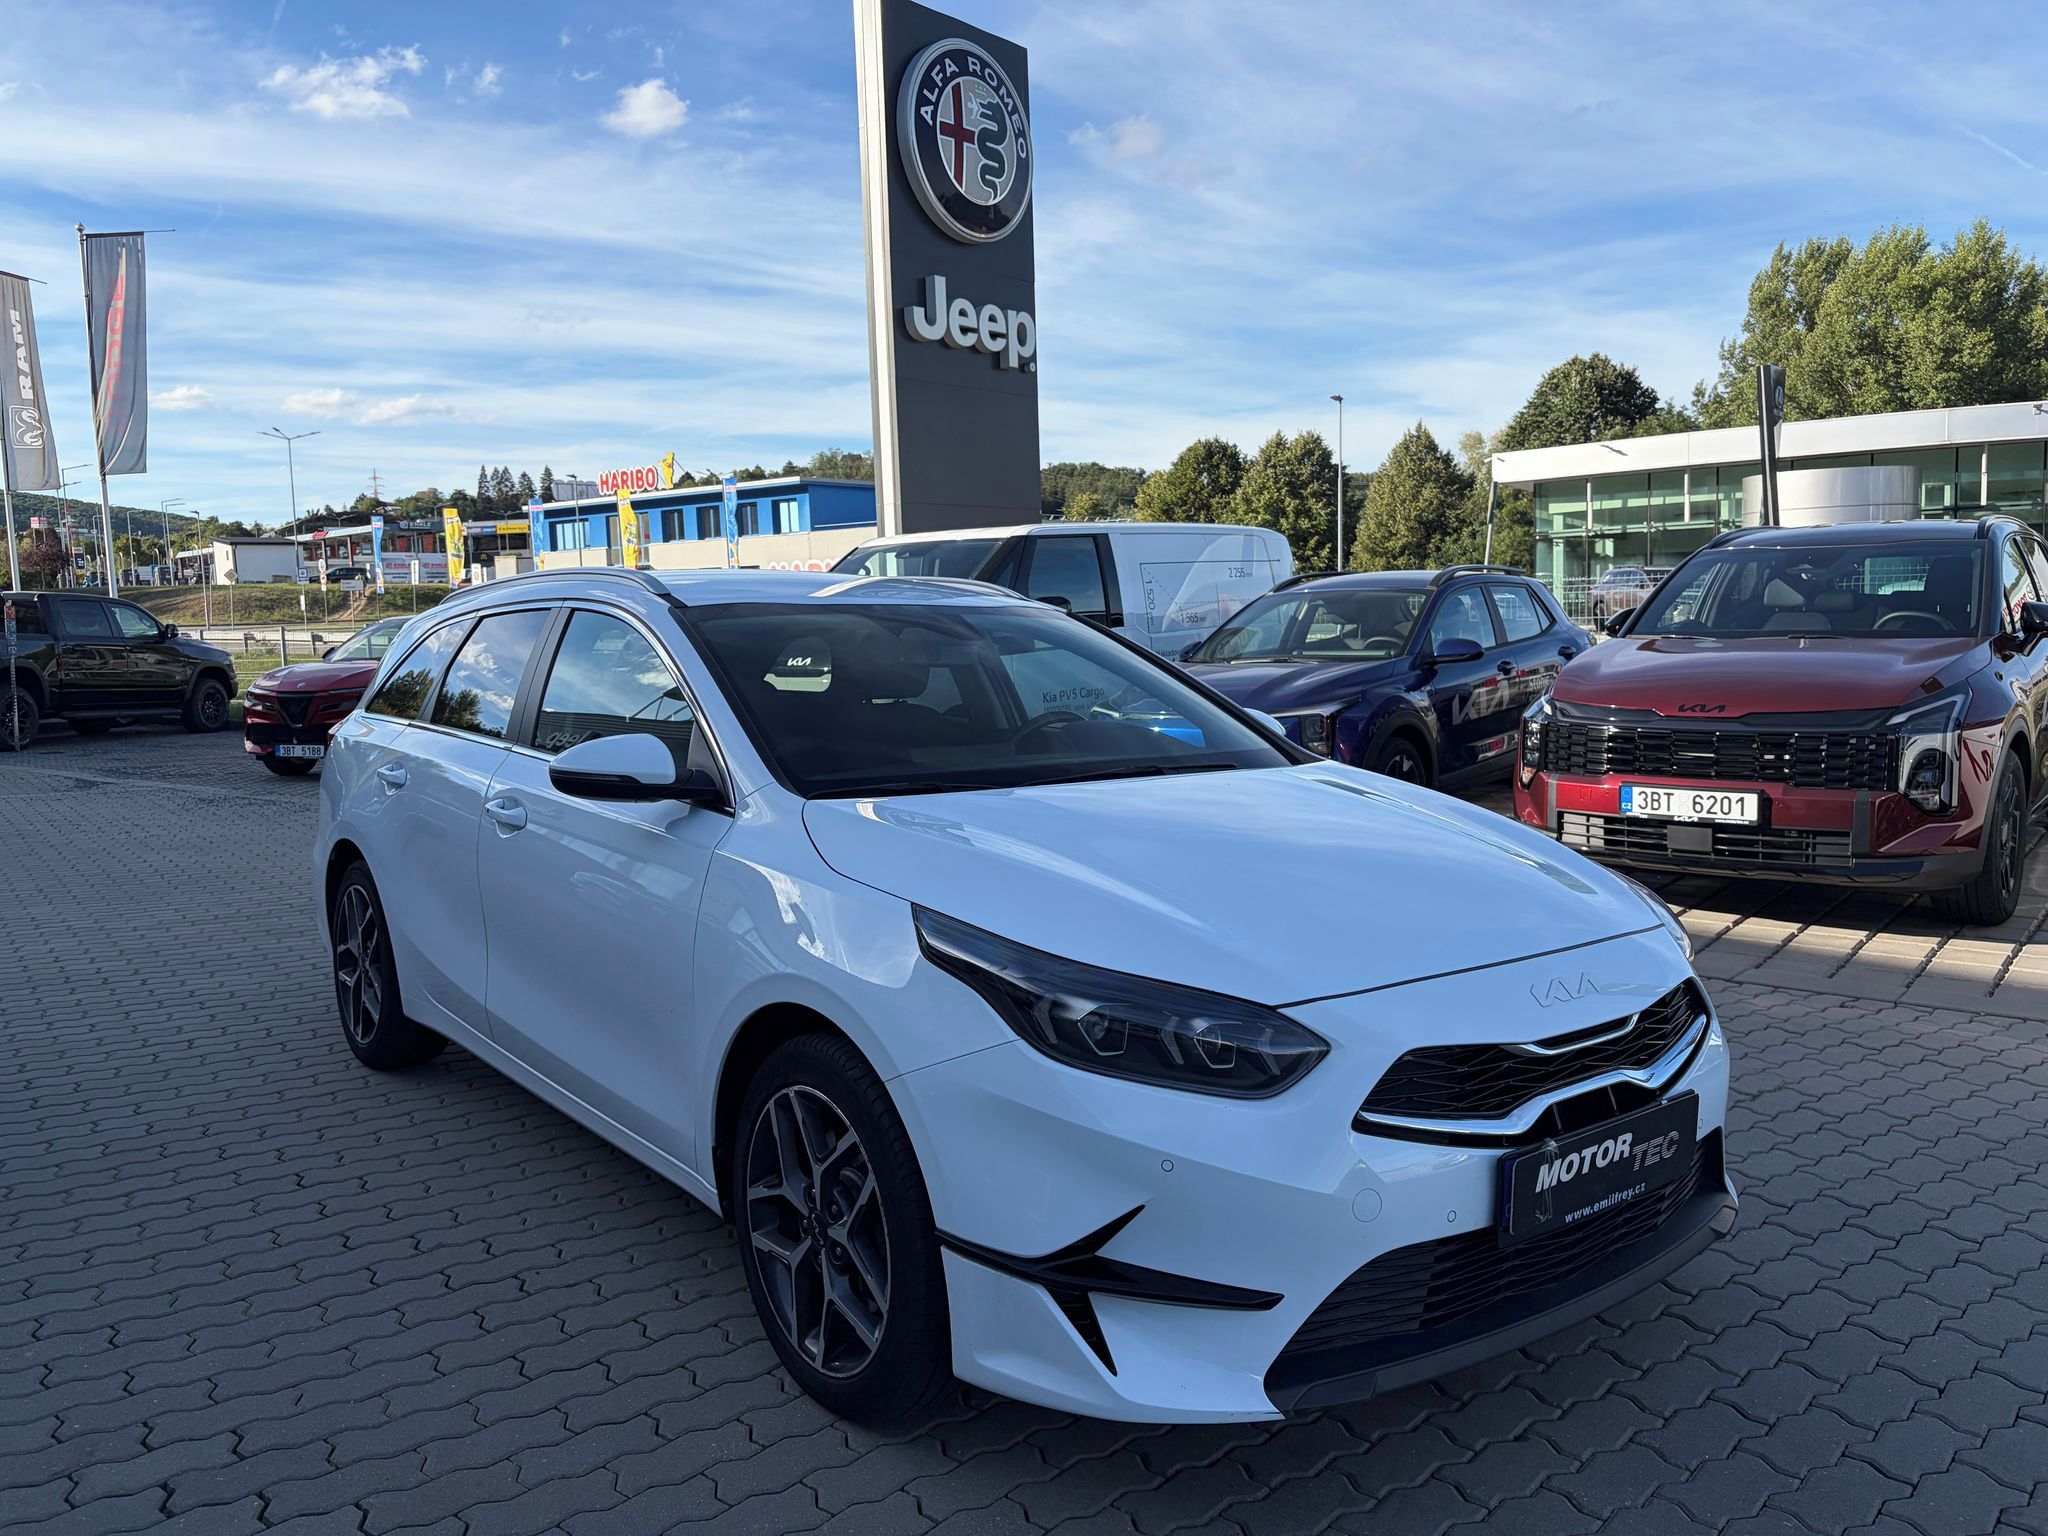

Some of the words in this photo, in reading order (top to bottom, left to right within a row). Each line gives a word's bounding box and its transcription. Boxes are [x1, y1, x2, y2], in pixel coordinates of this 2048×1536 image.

[919, 56, 959, 127] ALFA
[966, 55, 1027, 159] ROMEO
[904, 274, 1036, 370] Jeep
[10, 309, 34, 400] RAM
[599, 466, 657, 494] HARIBO
[787, 657, 812, 666] KIA
[1042, 691, 1057, 704] Kia
[1059, 687, 1077, 701] PV5
[1079, 686, 1105, 700] Cargo
[1452, 680, 1510, 726] KIA
[1679, 703, 1727, 713] KIA
[281, 746, 295, 756] 3BT
[1621, 802, 1632, 810] CZ
[1637, 790, 1674, 812] 3BT
[1692, 794, 1746, 817] 6201
[1673, 815, 1699, 823] KIA
[1530, 971, 1600, 1008] KIA
[1535, 1132, 1634, 1194] MOTOR
[1631, 1130, 1680, 1172] TEC
[1564, 1181, 1647, 1225] www.emilfrey.cz
